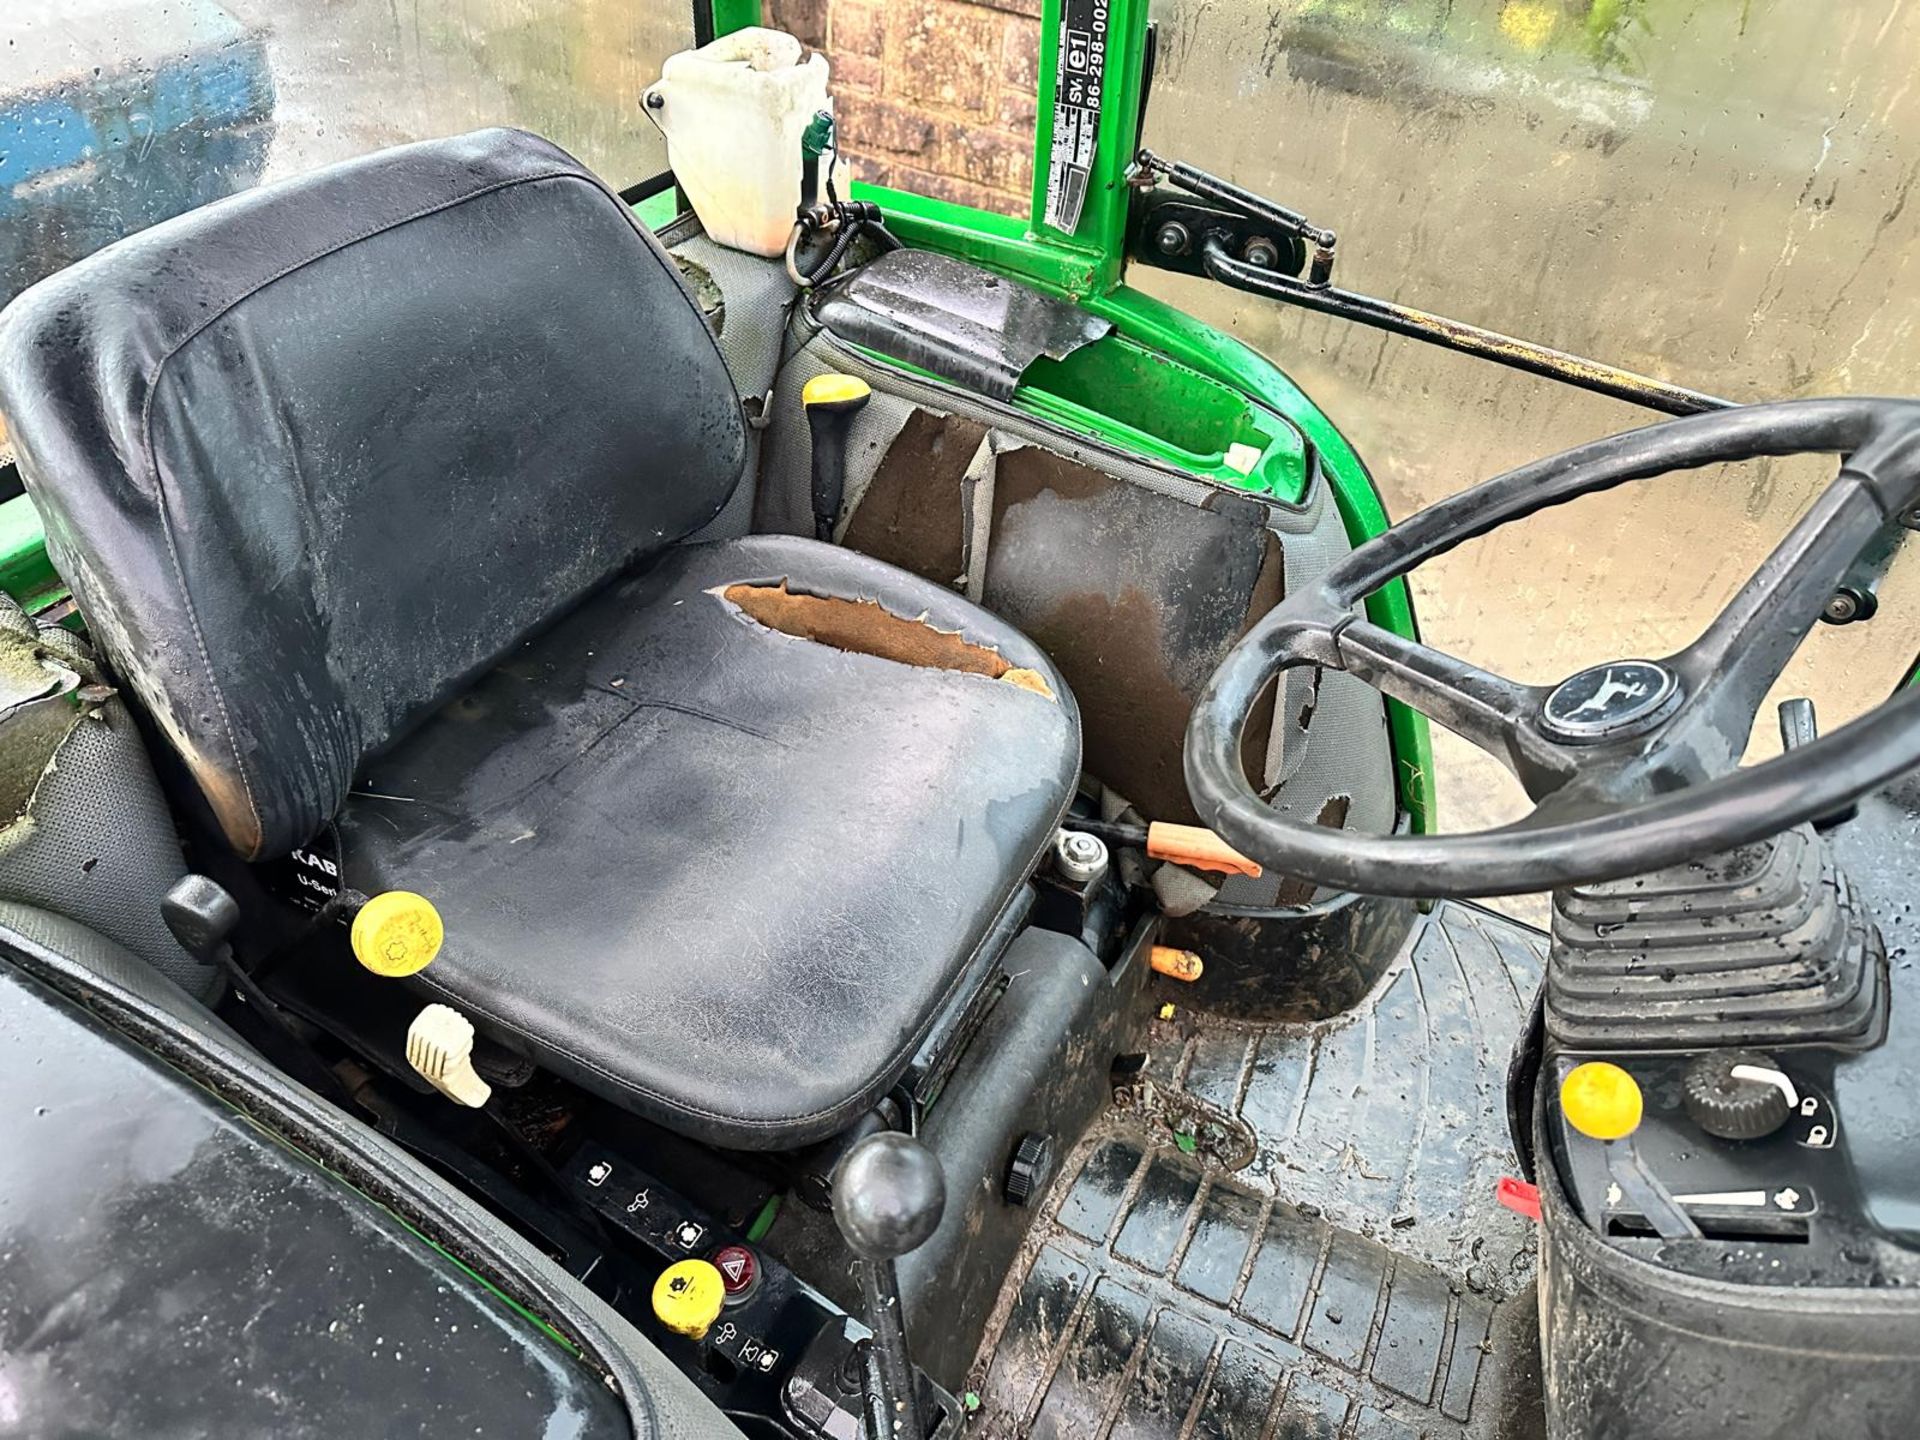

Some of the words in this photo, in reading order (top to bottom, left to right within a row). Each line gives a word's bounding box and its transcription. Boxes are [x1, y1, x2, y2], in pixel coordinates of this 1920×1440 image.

[1069, 38, 1086, 69] e1
[1087, 0, 1108, 108] 86-298-002
[291, 848, 337, 877] KAB
[297, 873, 338, 897] U-Seri
